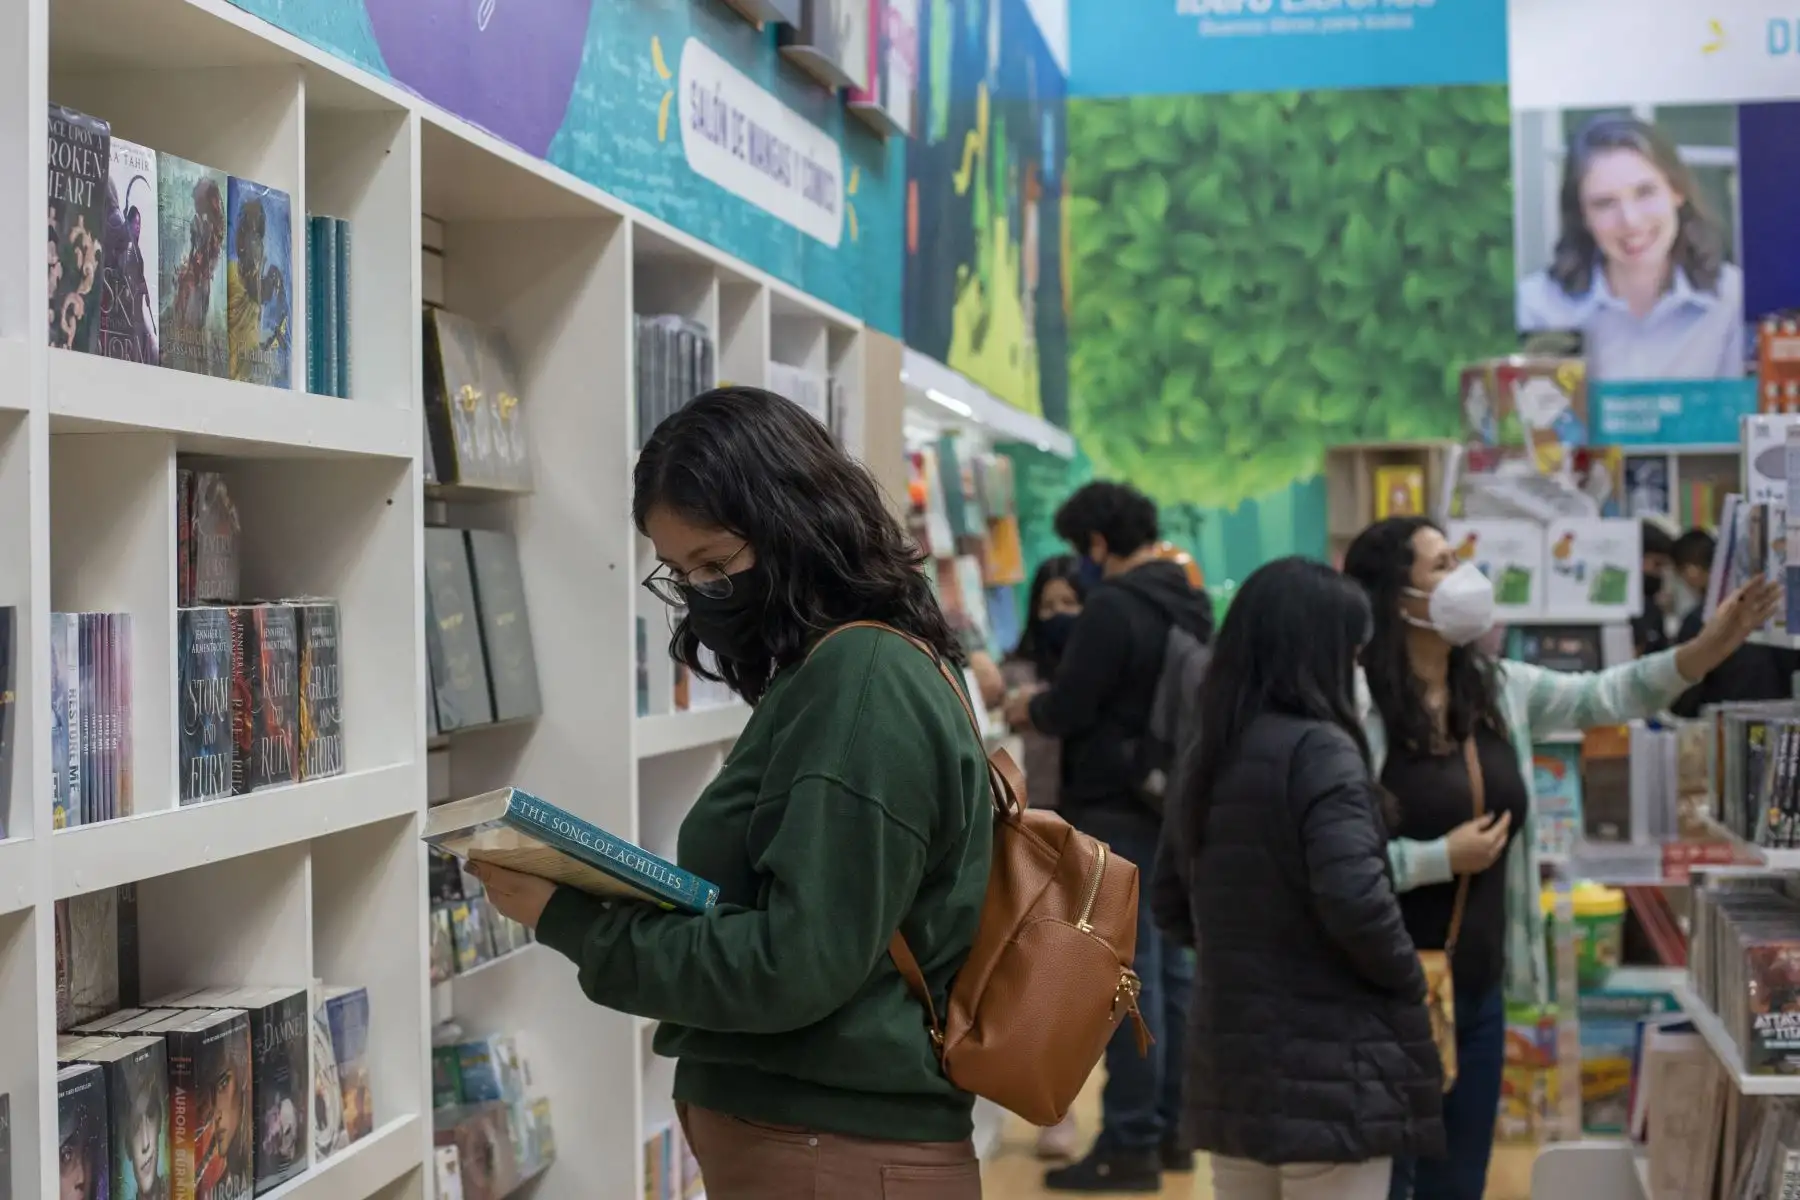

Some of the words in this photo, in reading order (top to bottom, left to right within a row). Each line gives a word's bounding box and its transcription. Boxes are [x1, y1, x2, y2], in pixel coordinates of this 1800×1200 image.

[48, 119, 67, 138] NCE
[68, 125, 93, 145] UPON
[731, 107, 745, 160] DE
[48, 138, 104, 179] ROKEN
[123, 153, 151, 172] TAHIR
[262, 661, 291, 700] RAGE
[308, 664, 338, 700] GRACE
[69, 687, 78, 761] RESTORE
[185, 677, 229, 735] STORM
[69, 765, 79, 793] ME
[191, 752, 228, 799] FURY
[261, 734, 295, 783] RUIN
[519, 801, 549, 824] THE
[551, 816, 591, 845] SONG
[594, 838, 613, 857] OF
[616, 849, 682, 889] ACHILLES
[175, 1086, 187, 1145] AURORA
